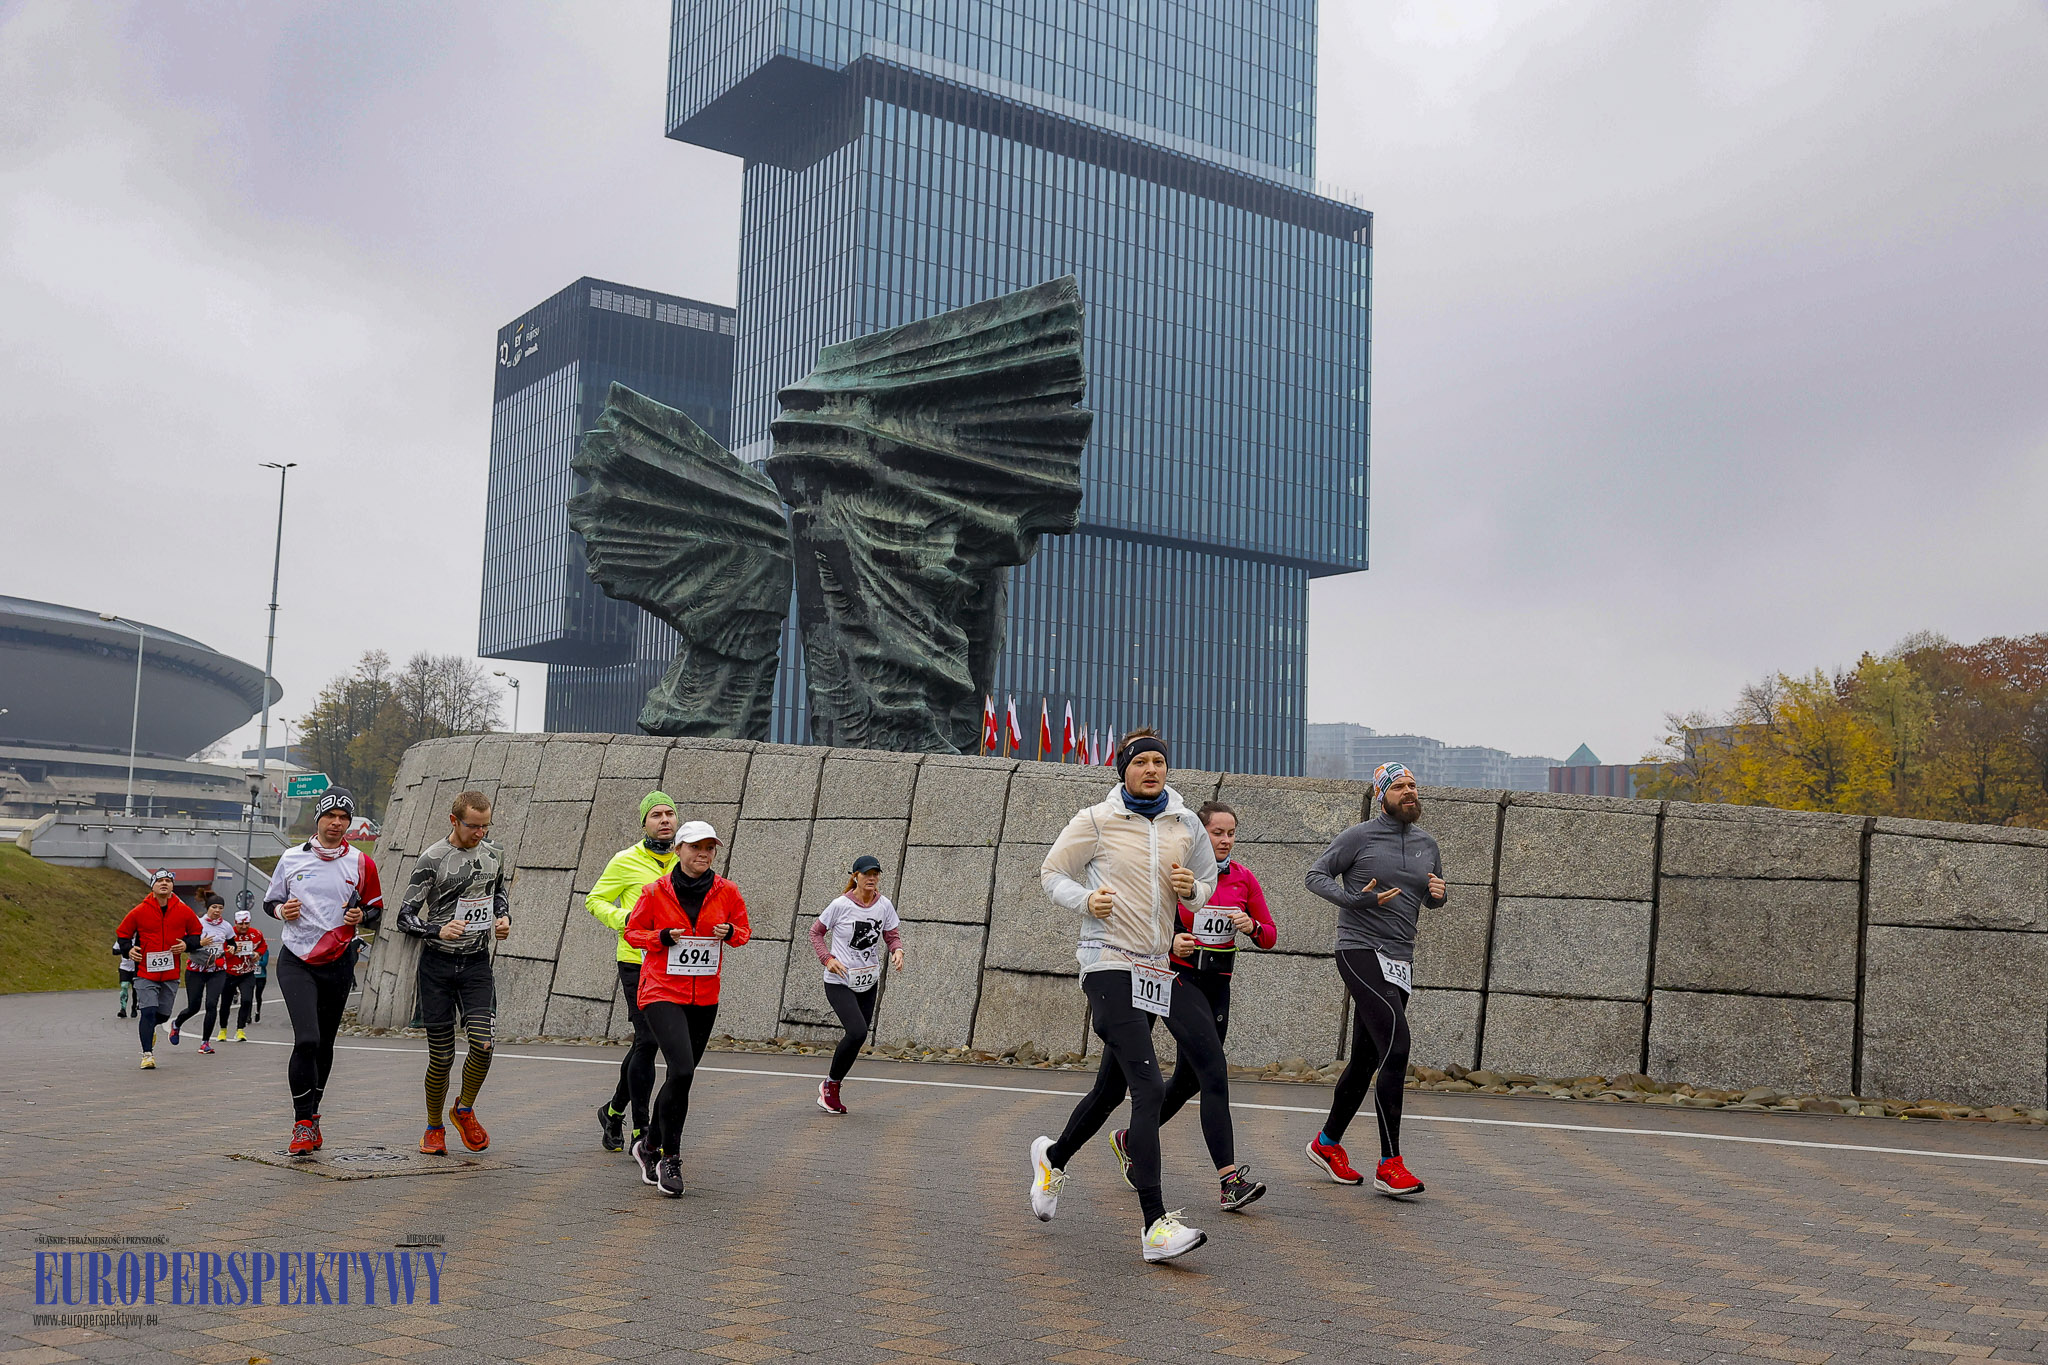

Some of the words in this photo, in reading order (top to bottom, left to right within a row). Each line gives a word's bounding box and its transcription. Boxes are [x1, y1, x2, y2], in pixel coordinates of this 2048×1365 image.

[464, 907, 488, 922] 695
[1203, 918, 1233, 934] 404
[151, 957, 169, 967] 639
[678, 948, 710, 965] 694
[1386, 961, 1407, 981] 255
[855, 973, 873, 986] 322
[1139, 978, 1162, 1002] 701
